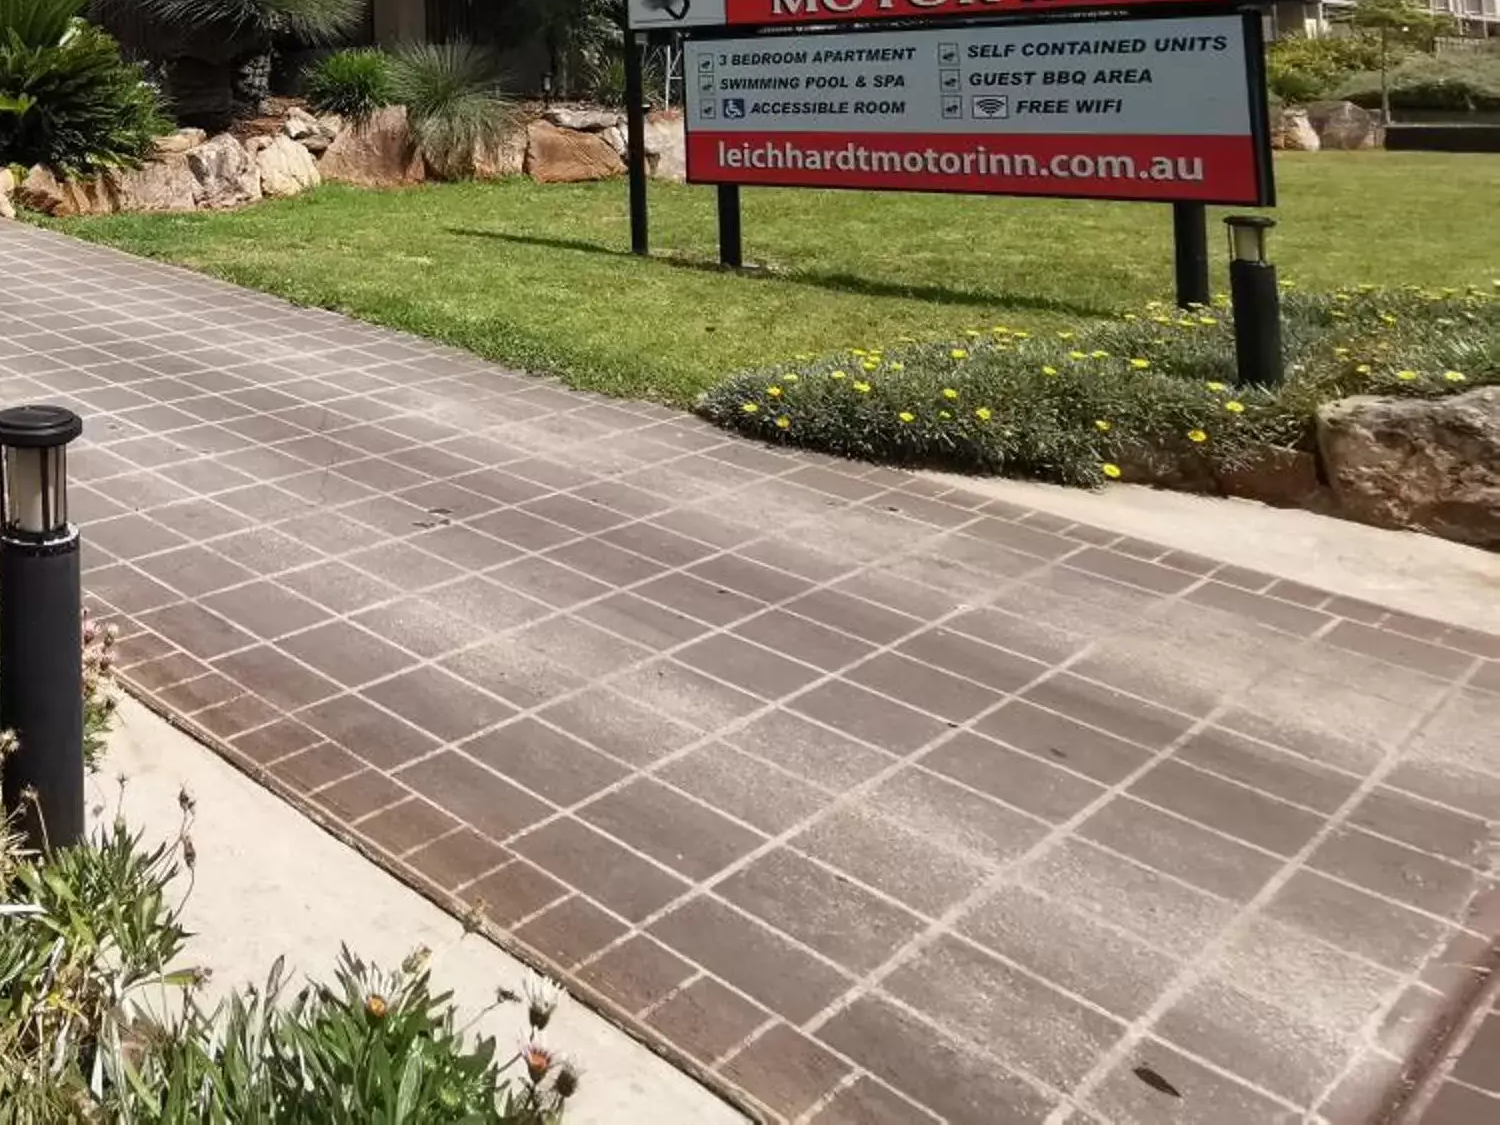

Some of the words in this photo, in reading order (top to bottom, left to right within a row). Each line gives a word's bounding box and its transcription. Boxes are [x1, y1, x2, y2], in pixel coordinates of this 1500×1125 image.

[718, 55, 728, 66] 3
[731, 50, 807, 66] BEDROOM
[812, 47, 916, 64] APARTMENT
[967, 43, 1016, 59] SELF
[1021, 38, 1146, 58] CONTAINED
[1154, 36, 1228, 53] UNITS
[719, 75, 800, 91] SWIMMING
[805, 76, 849, 90] POOL
[855, 76, 867, 89] &
[873, 75, 906, 88] SPA
[969, 71, 1037, 87] GUEST
[1042, 70, 1086, 86] BBQ
[1093, 69, 1153, 85] AREA
[750, 101, 849, 115] ACCESSIBLE
[854, 101, 906, 115] ROOM
[1015, 100, 1070, 115] FREE
[1075, 99, 1123, 114] WIFI
[717, 141, 1204, 181] leichhardtmotorinn.com.au
